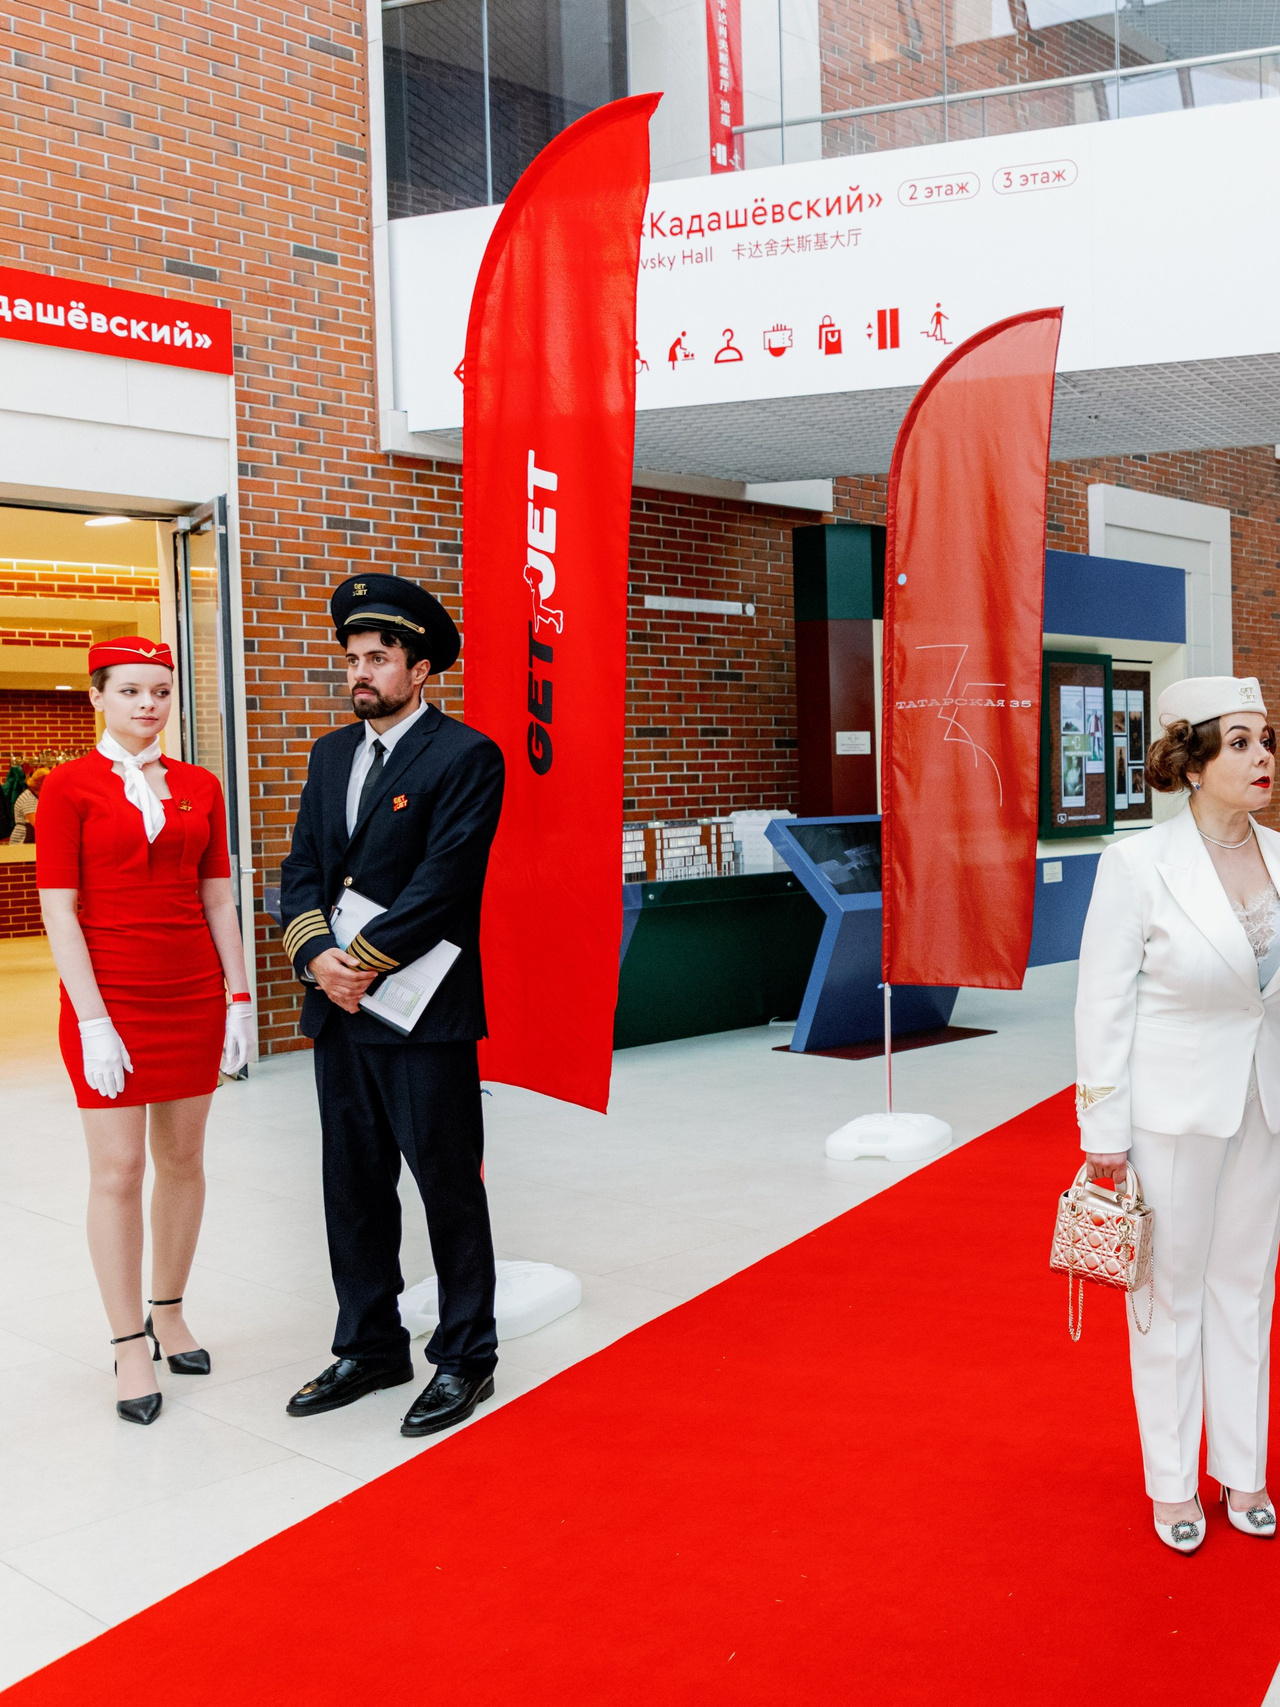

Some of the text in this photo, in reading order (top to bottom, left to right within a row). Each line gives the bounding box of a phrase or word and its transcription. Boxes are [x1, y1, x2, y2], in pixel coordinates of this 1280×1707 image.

[1002, 168, 1067, 189] 3 этаж
[908, 181, 970, 201] 2 этаж
[731, 227, 862, 260] 卡达舍夫斯基大厅
[682, 246, 713, 265] Hall
[527, 620, 553, 776] GET
[895, 697, 1032, 710] ТАТАРСКАЯ 35
